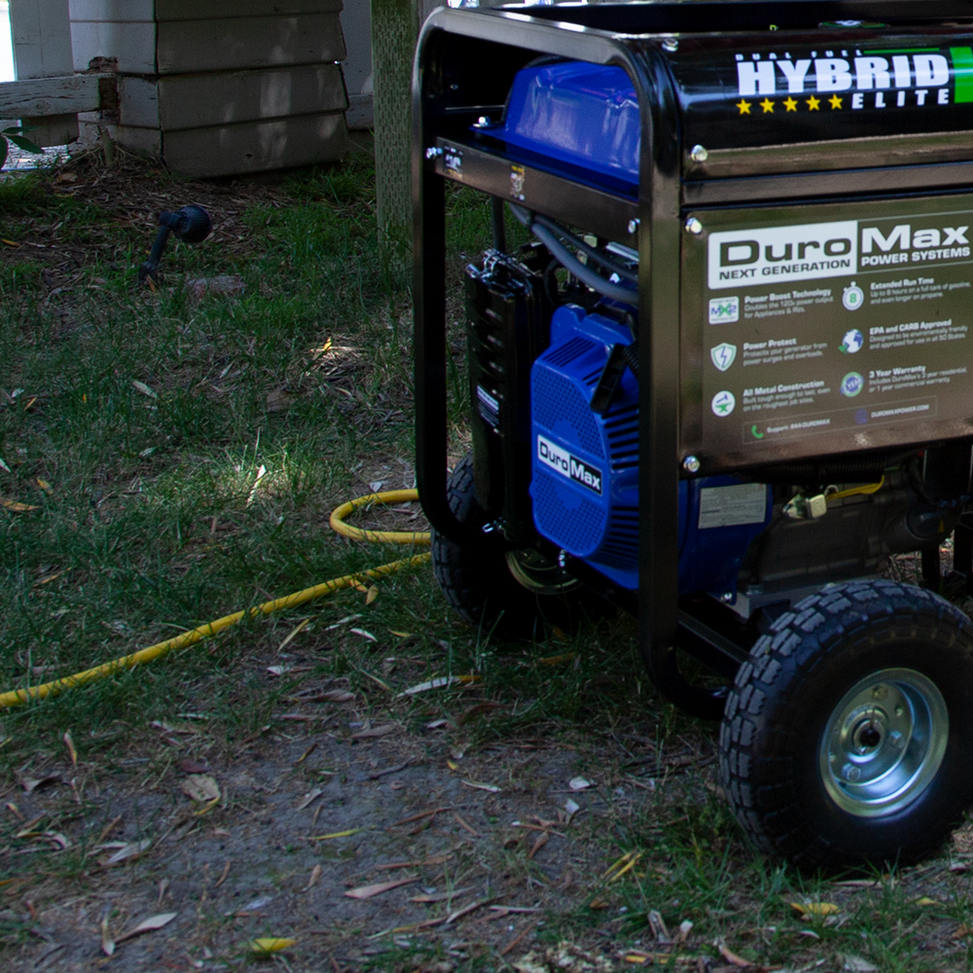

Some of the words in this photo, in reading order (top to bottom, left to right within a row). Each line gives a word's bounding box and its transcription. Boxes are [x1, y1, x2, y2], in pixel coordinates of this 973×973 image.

[735, 51, 792, 61] DUAL
[811, 49, 863, 59] FUEL
[737, 54, 950, 96] HYBRID
[852, 88, 950, 109] ELITE
[719, 225, 970, 268] DuroMax
[861, 253, 909, 267] POWER
[912, 247, 971, 262] SYSTEMS
[719, 269, 756, 281] NEXT
[762, 259, 851, 276] GENERATION
[540, 440, 601, 490] DuroMax
